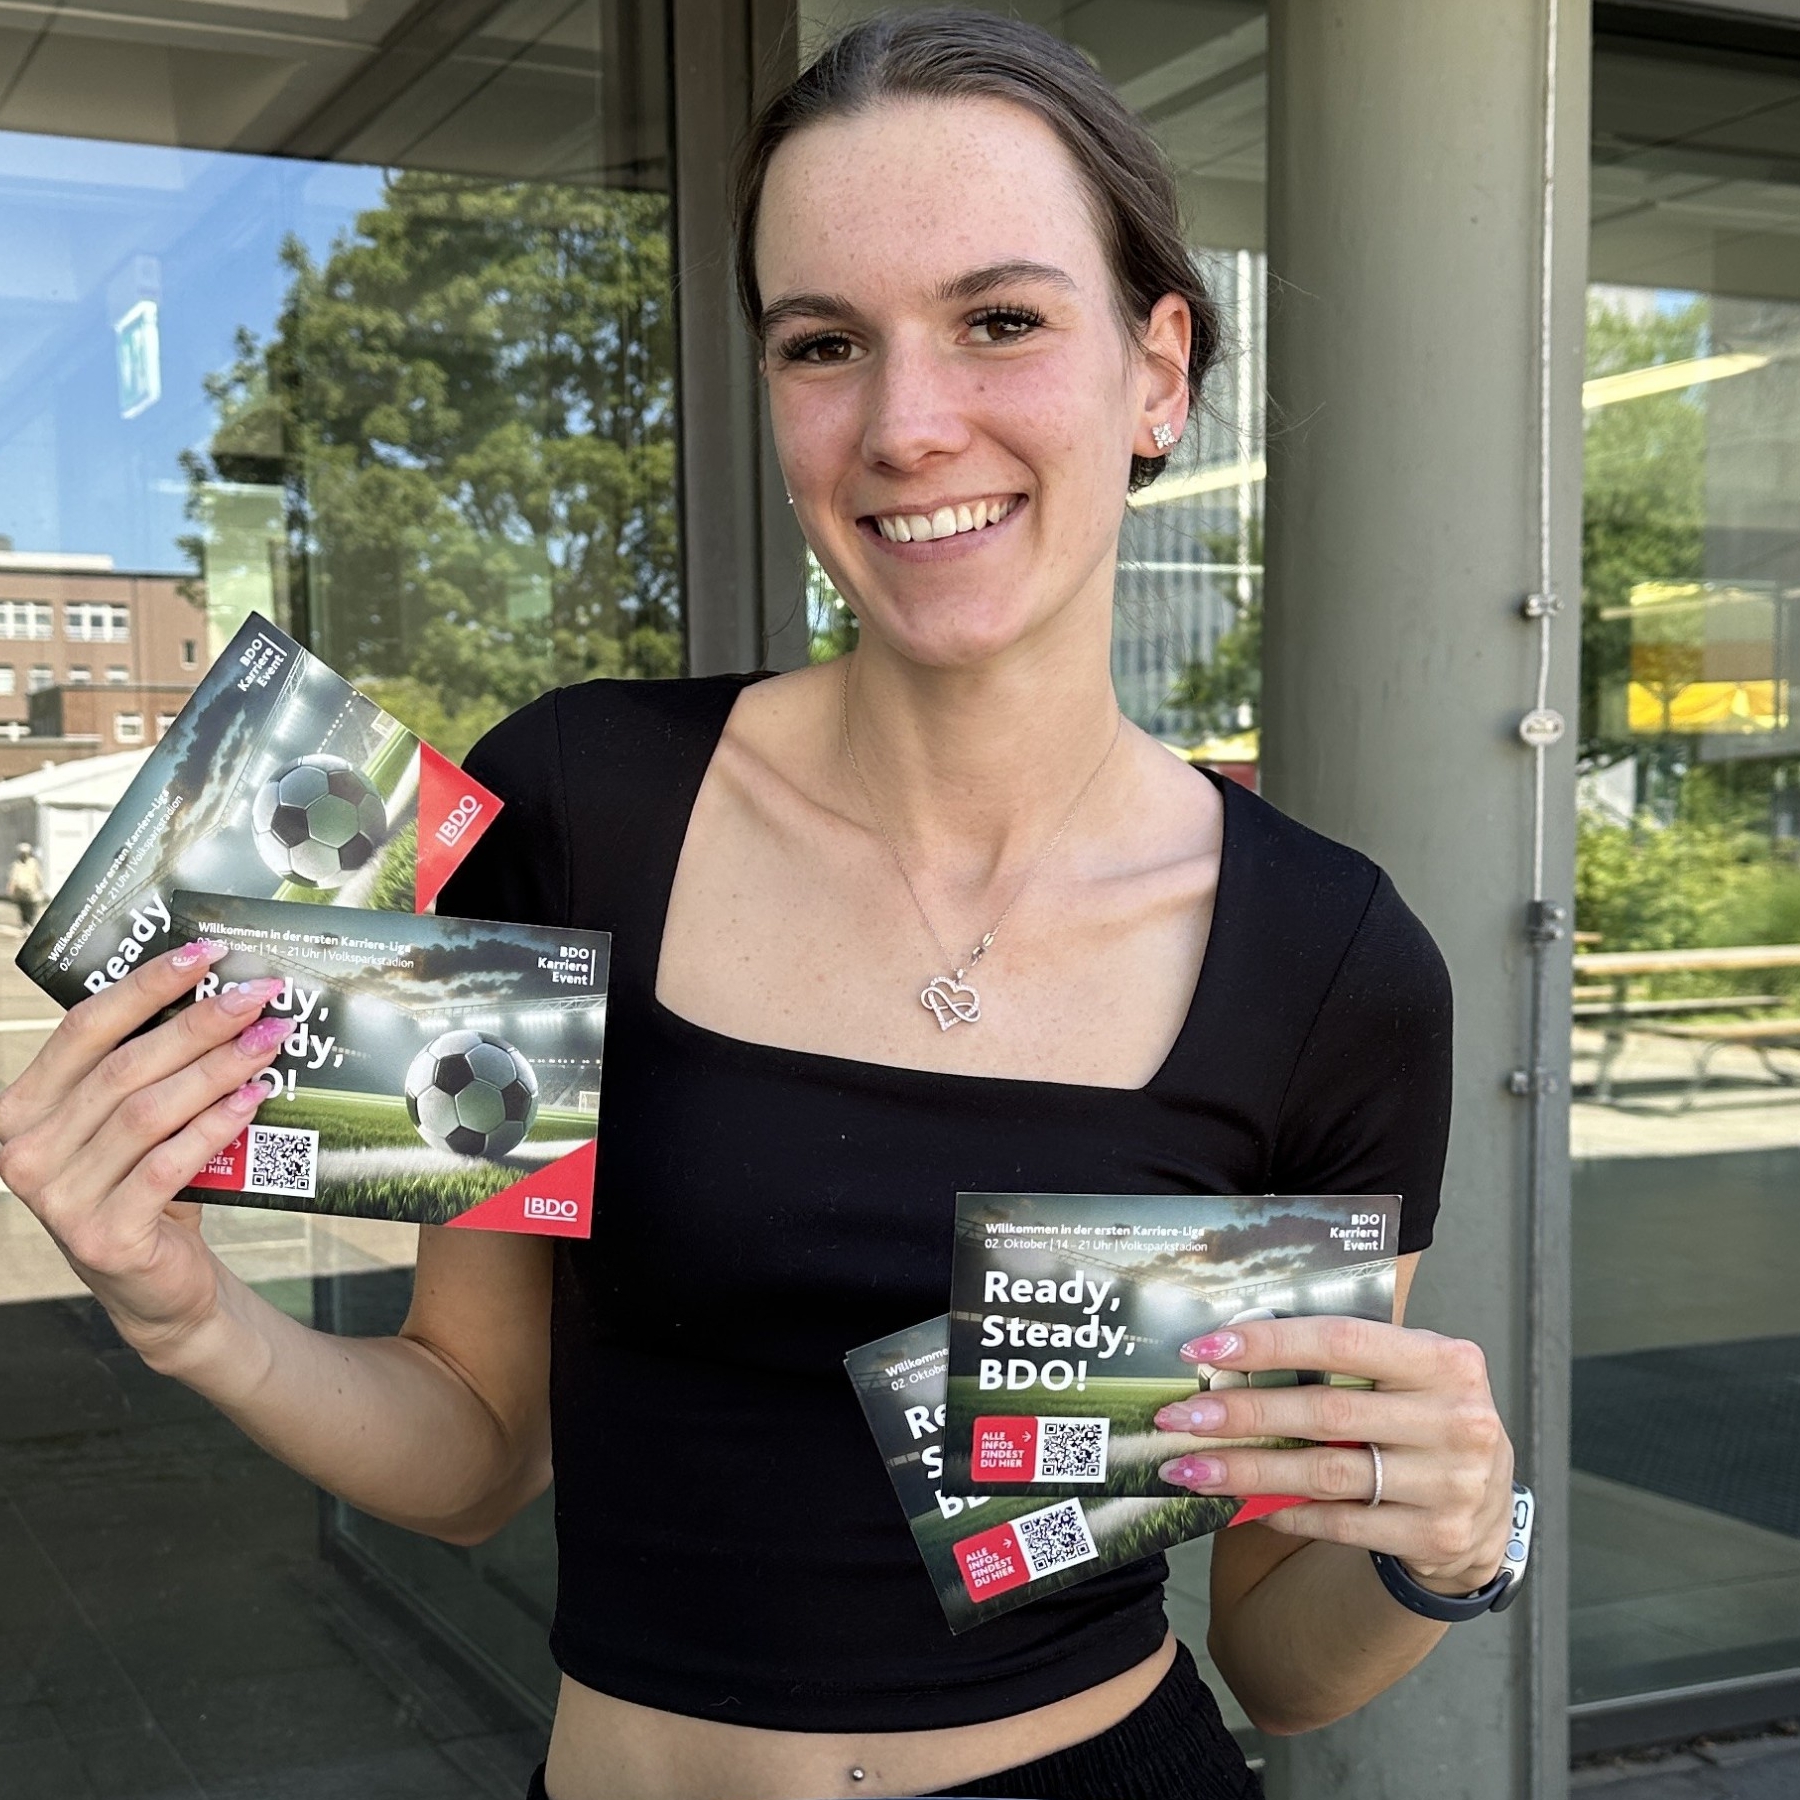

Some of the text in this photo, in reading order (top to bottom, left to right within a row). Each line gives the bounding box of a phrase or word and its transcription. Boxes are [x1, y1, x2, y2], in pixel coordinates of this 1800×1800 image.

[239, 639, 263, 667] BDO
[237, 648, 274, 692] Karriere
[256, 655, 284, 687] Event
[438, 795, 480, 840] BDO
[48, 788, 169, 961] Willkommen in der ersten Karriere-Liga
[70, 920, 97, 956] Oktober
[96, 903, 109, 916] 14
[108, 886, 119, 900] 21
[115, 870, 130, 888] Uhr
[129, 795, 183, 866] Volksparkstadion
[198, 922, 411, 955] Willkommen in der ersten Karriere-Liga
[266, 943, 278, 955] 14
[287, 946, 298, 957] 21
[301, 947, 320, 959] Uhr
[328, 949, 414, 968] Volksparkstadion
[560, 946, 590, 959] BDO
[537, 956, 589, 972] Karriere
[552, 971, 588, 985] Event
[195, 971, 329, 1022] Rdy,
[208, 1165, 233, 1175] HIER
[528, 1197, 578, 1218] BDO
[1351, 1214, 1380, 1225] BDO
[985, 1223, 1205, 1240] Willkommen in der ersten Karriere-Liga
[1330, 1227, 1379, 1238] Karriere
[984, 1239, 1001, 1249] 02.
[1003, 1238, 1048, 1249] Oktober
[1056, 1239, 1068, 1249] 14
[1078, 1240, 1090, 1250] 21
[1093, 1240, 1112, 1250] Uhr
[1120, 1241, 1208, 1253] Volksparkstadion
[1344, 1240, 1378, 1251] Event
[984, 1270, 1121, 1314] Ready,
[980, 1315, 1135, 1359] Steady,
[885, 1348, 949, 1377] Willkomme
[891, 1364, 947, 1391] 02. Oktobe
[979, 1359, 1088, 1392] BDO!
[981, 1432, 1006, 1440] ALLE
[981, 1440, 1014, 1449] INFOS
[980, 1459, 1022, 1468] DU HIER
[981, 1450, 1025, 1459] FINDEST
[966, 1547, 989, 1563] ALLE
[968, 1553, 1000, 1571] INFOS
[971, 1556, 1012, 1579] FINDEST
[974, 1565, 1015, 1588] DU HIER
